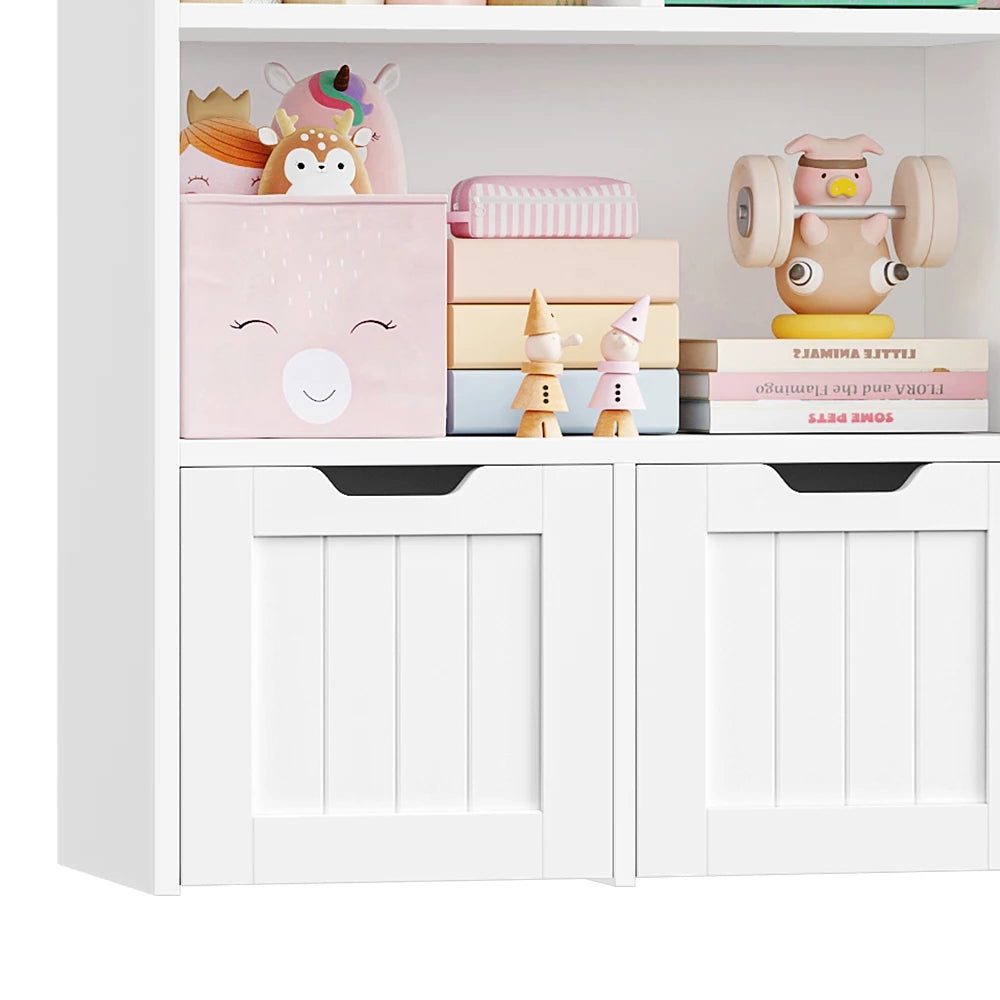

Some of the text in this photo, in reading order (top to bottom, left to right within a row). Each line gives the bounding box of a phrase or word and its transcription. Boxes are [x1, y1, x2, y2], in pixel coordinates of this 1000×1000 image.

[755, 382, 944, 397] FLORA and the Flamingo
[808, 411, 894, 424] SOME PETS
